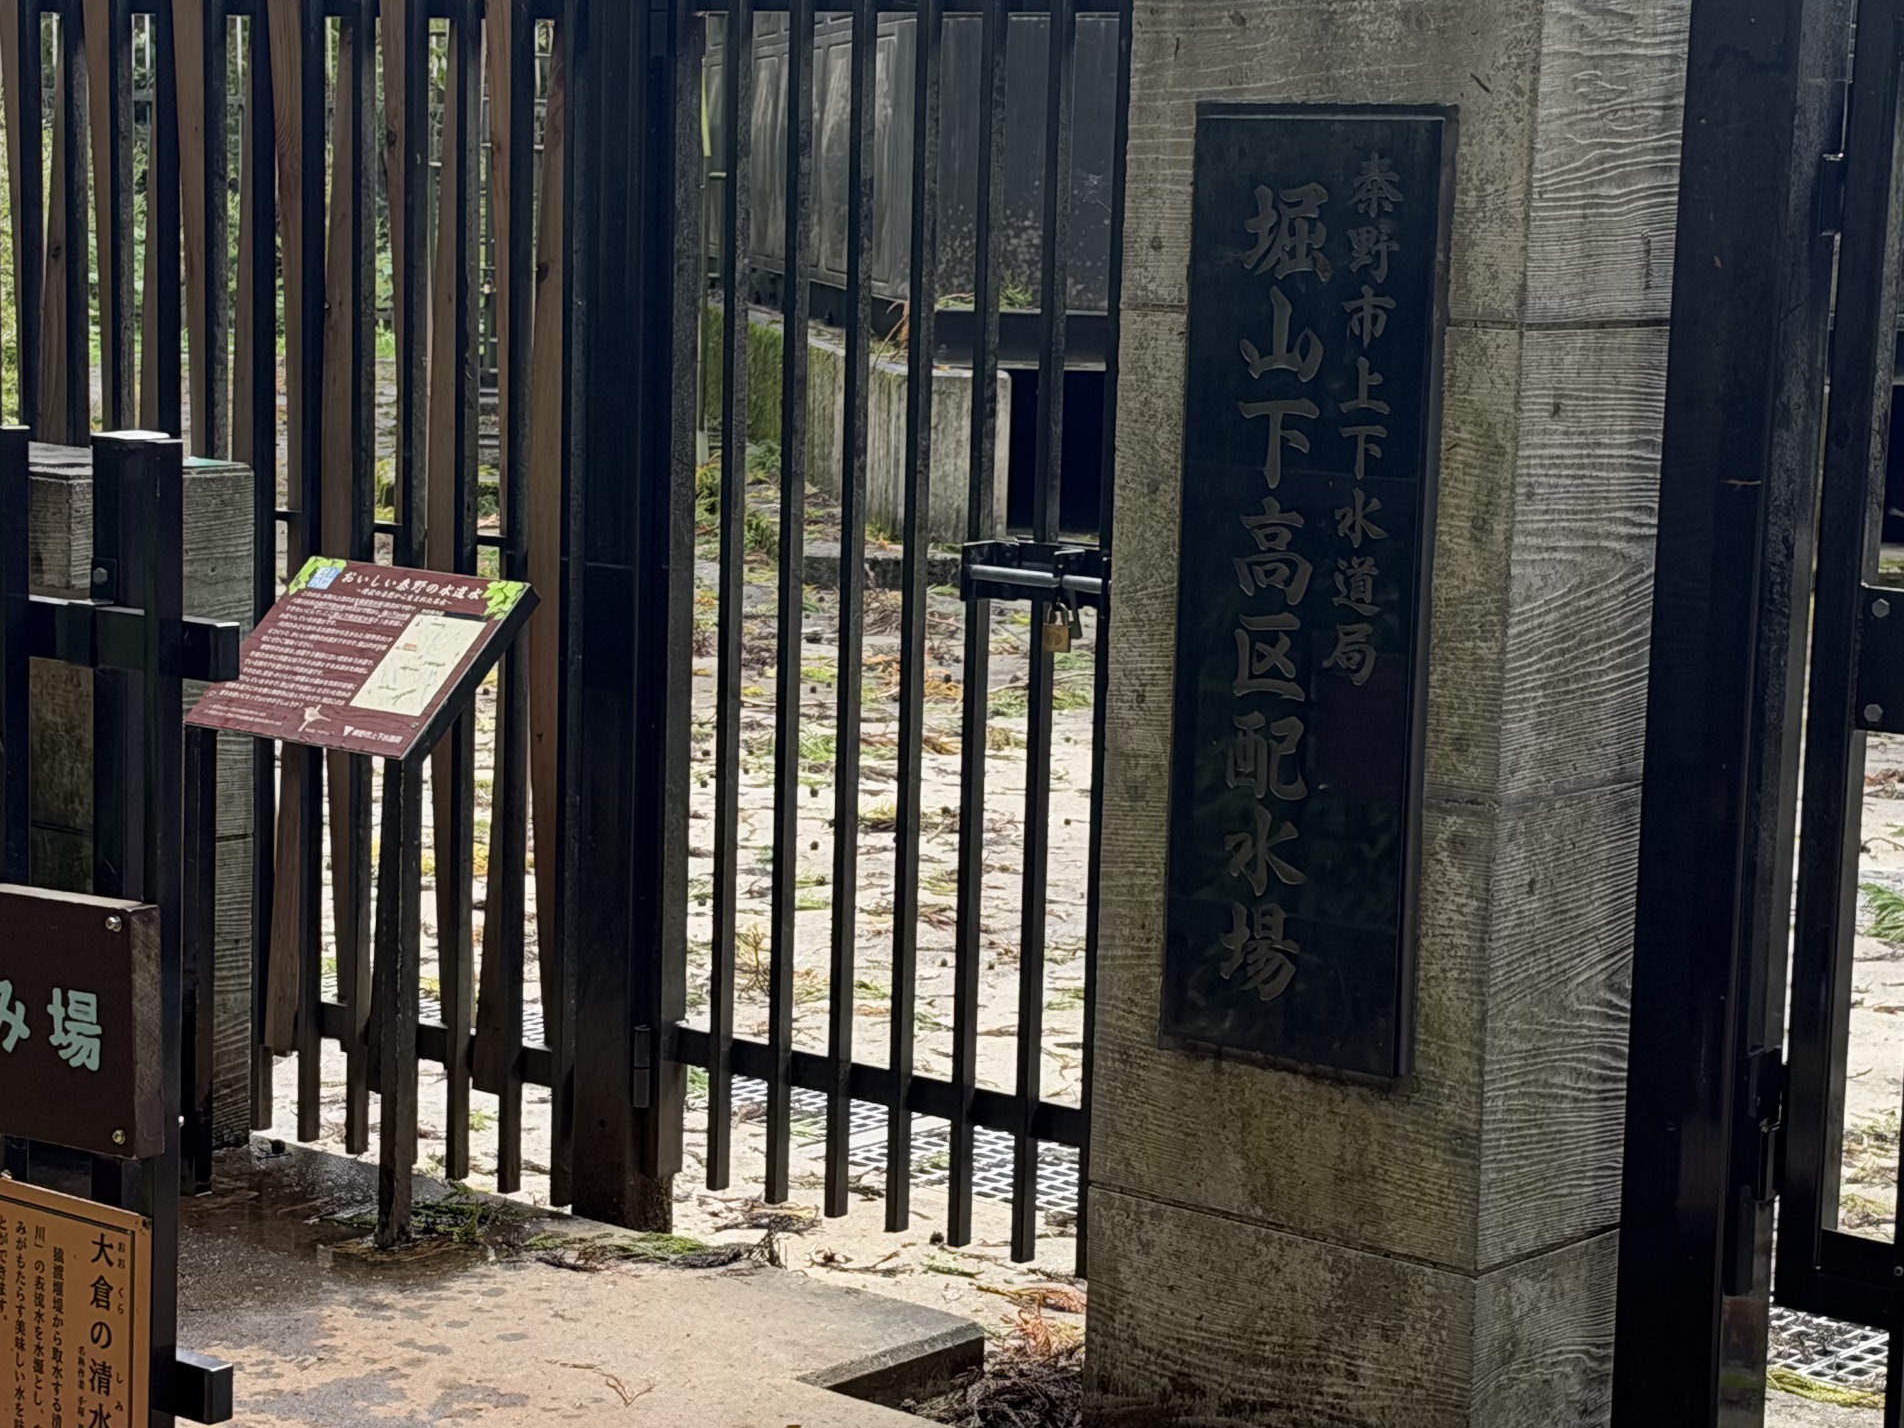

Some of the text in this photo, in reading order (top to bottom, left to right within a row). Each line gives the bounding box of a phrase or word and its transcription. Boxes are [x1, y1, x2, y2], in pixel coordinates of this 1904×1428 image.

[1219, 183, 1334, 1003] 堀山下高区配水場
[1320, 150, 1405, 689] 秦野市上下水道局
[116, 1287, 125, 1315] くら
